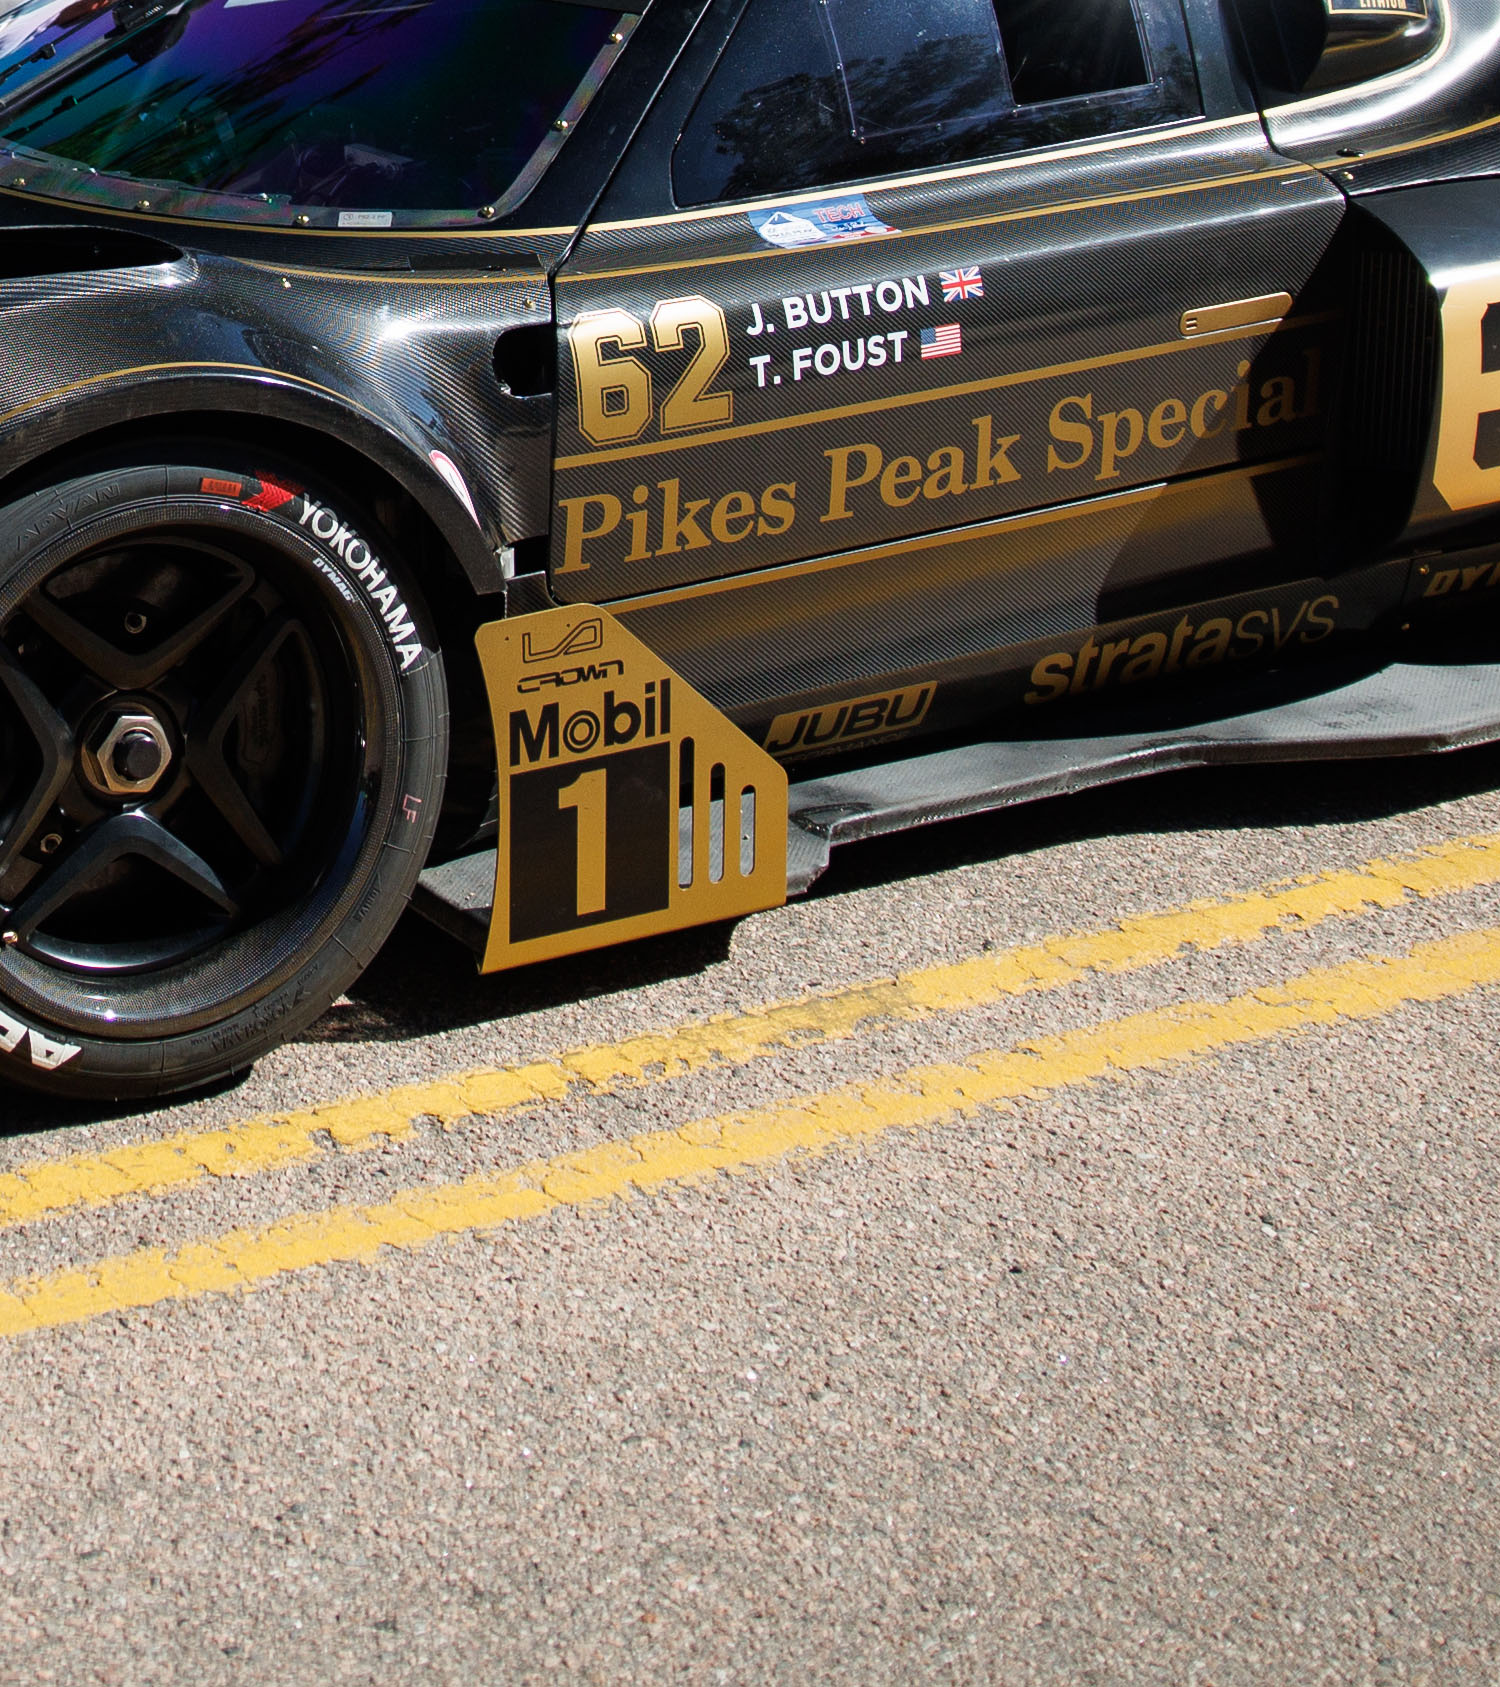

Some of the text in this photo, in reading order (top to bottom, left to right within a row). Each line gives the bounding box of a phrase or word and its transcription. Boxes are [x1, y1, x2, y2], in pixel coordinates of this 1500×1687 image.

[813, 201, 866, 223] TECH
[746, 273, 931, 337] J. BUTTON
[569, 294, 735, 447] 62
[749, 330, 909, 389] T. FOUST
[554, 346, 1322, 577] Pikes Peak Special
[298, 492, 423, 671] YOKOHAMA
[312, 556, 356, 604] DYMAG
[516, 657, 625, 694] CROWN
[1024, 594, 1341, 706] stratasys
[509, 678, 673, 768] Mobil
[766, 687, 932, 754] JUBU
[557, 767, 608, 918] 1
